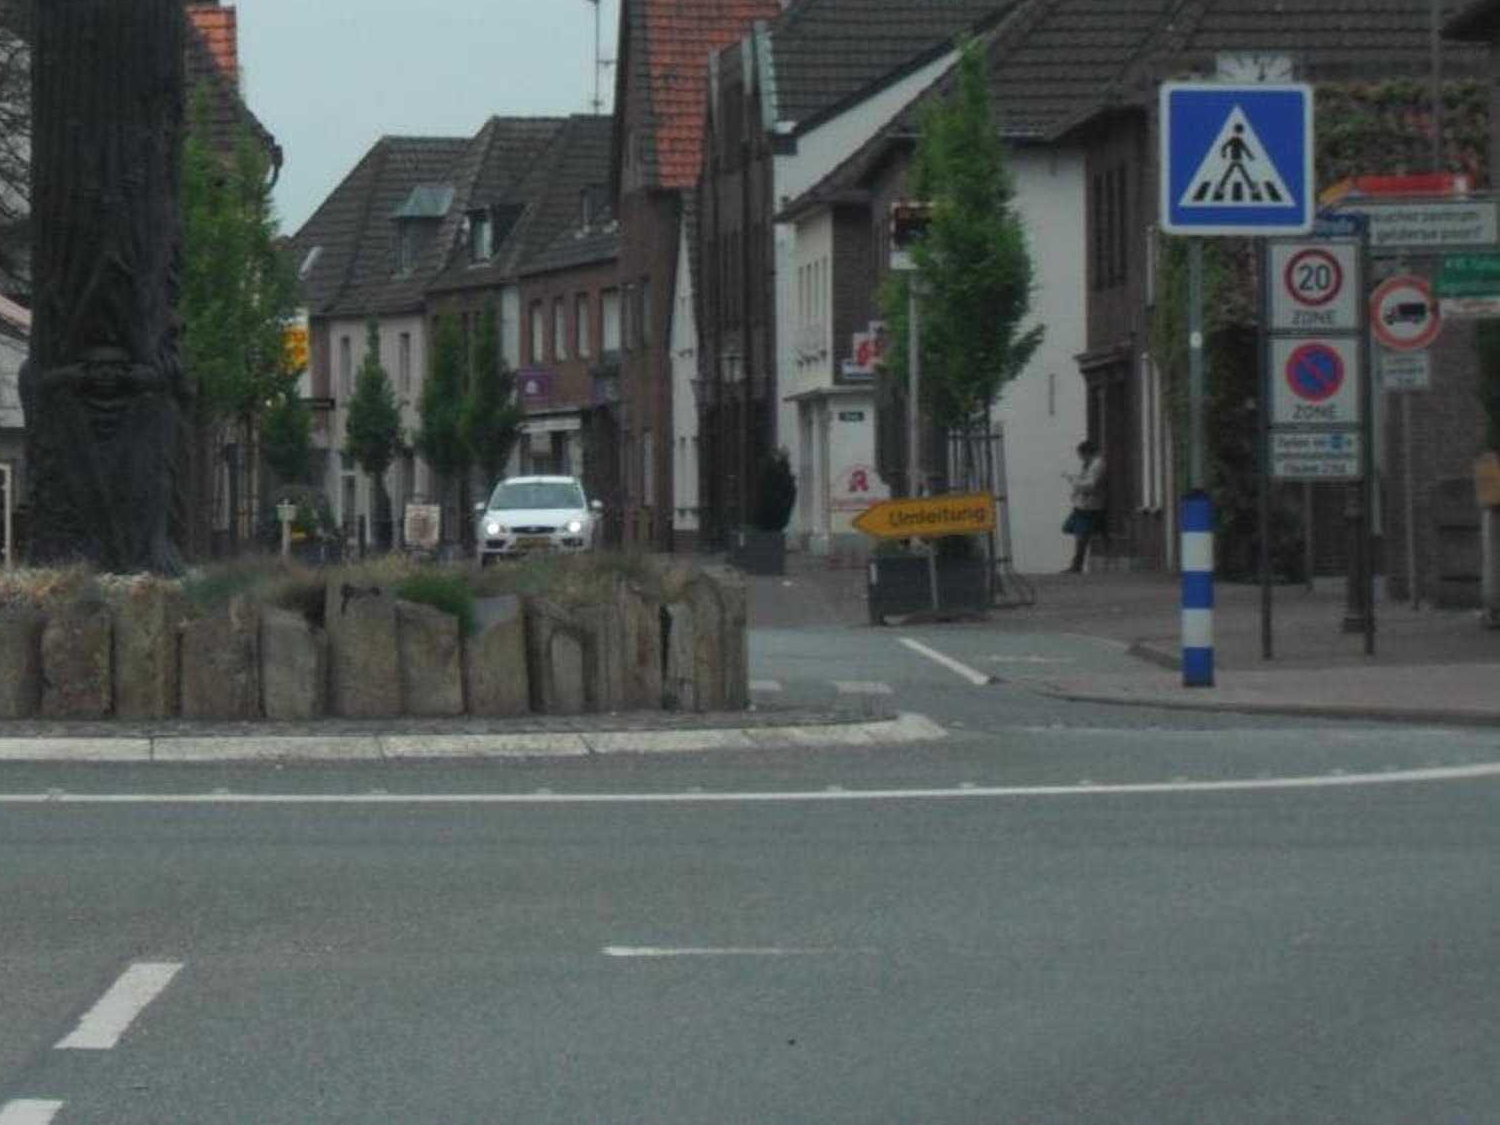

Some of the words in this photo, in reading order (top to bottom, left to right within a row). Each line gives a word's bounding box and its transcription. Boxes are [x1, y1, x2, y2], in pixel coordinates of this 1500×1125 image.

[1298, 264, 1332, 291] 20
[1292, 309, 1336, 325] ZONE
[1293, 405, 1337, 420] ZONE
[889, 506, 985, 528] Umleitung
